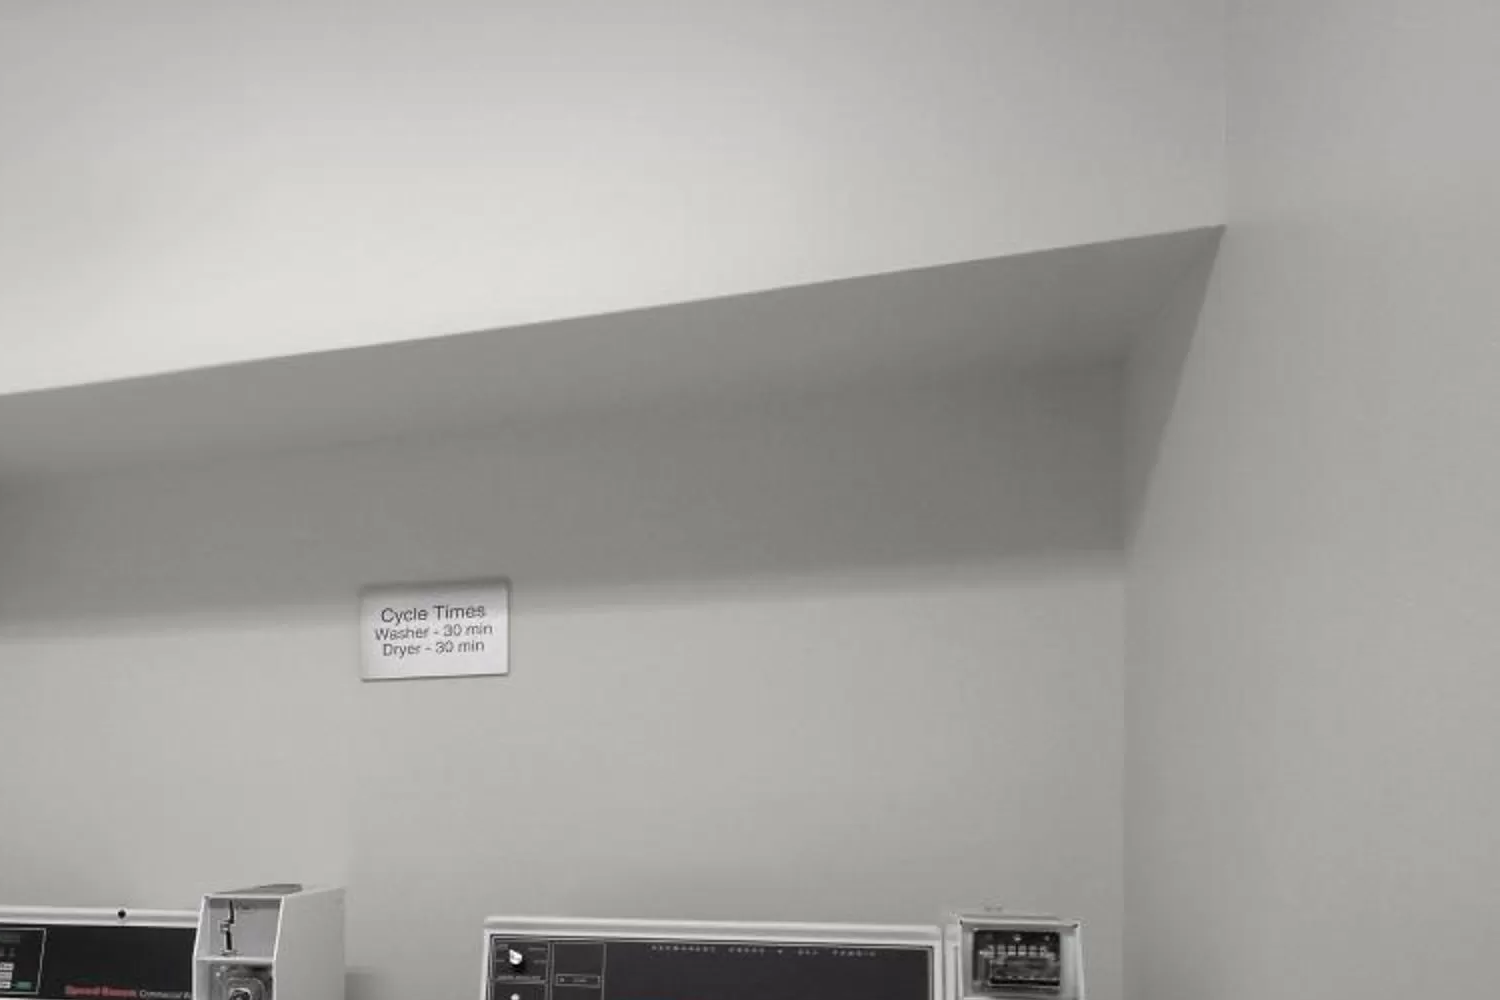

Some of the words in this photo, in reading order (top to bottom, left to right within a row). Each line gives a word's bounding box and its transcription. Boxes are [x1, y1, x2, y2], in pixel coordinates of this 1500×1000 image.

[380, 607, 428, 626] Cycle
[432, 604, 487, 620] Times
[374, 626, 429, 641] Washer
[443, 623, 462, 637] 30
[465, 623, 493, 636] min
[382, 643, 421, 659] Dryer
[435, 640, 454, 655] 30
[457, 639, 485, 653] min
